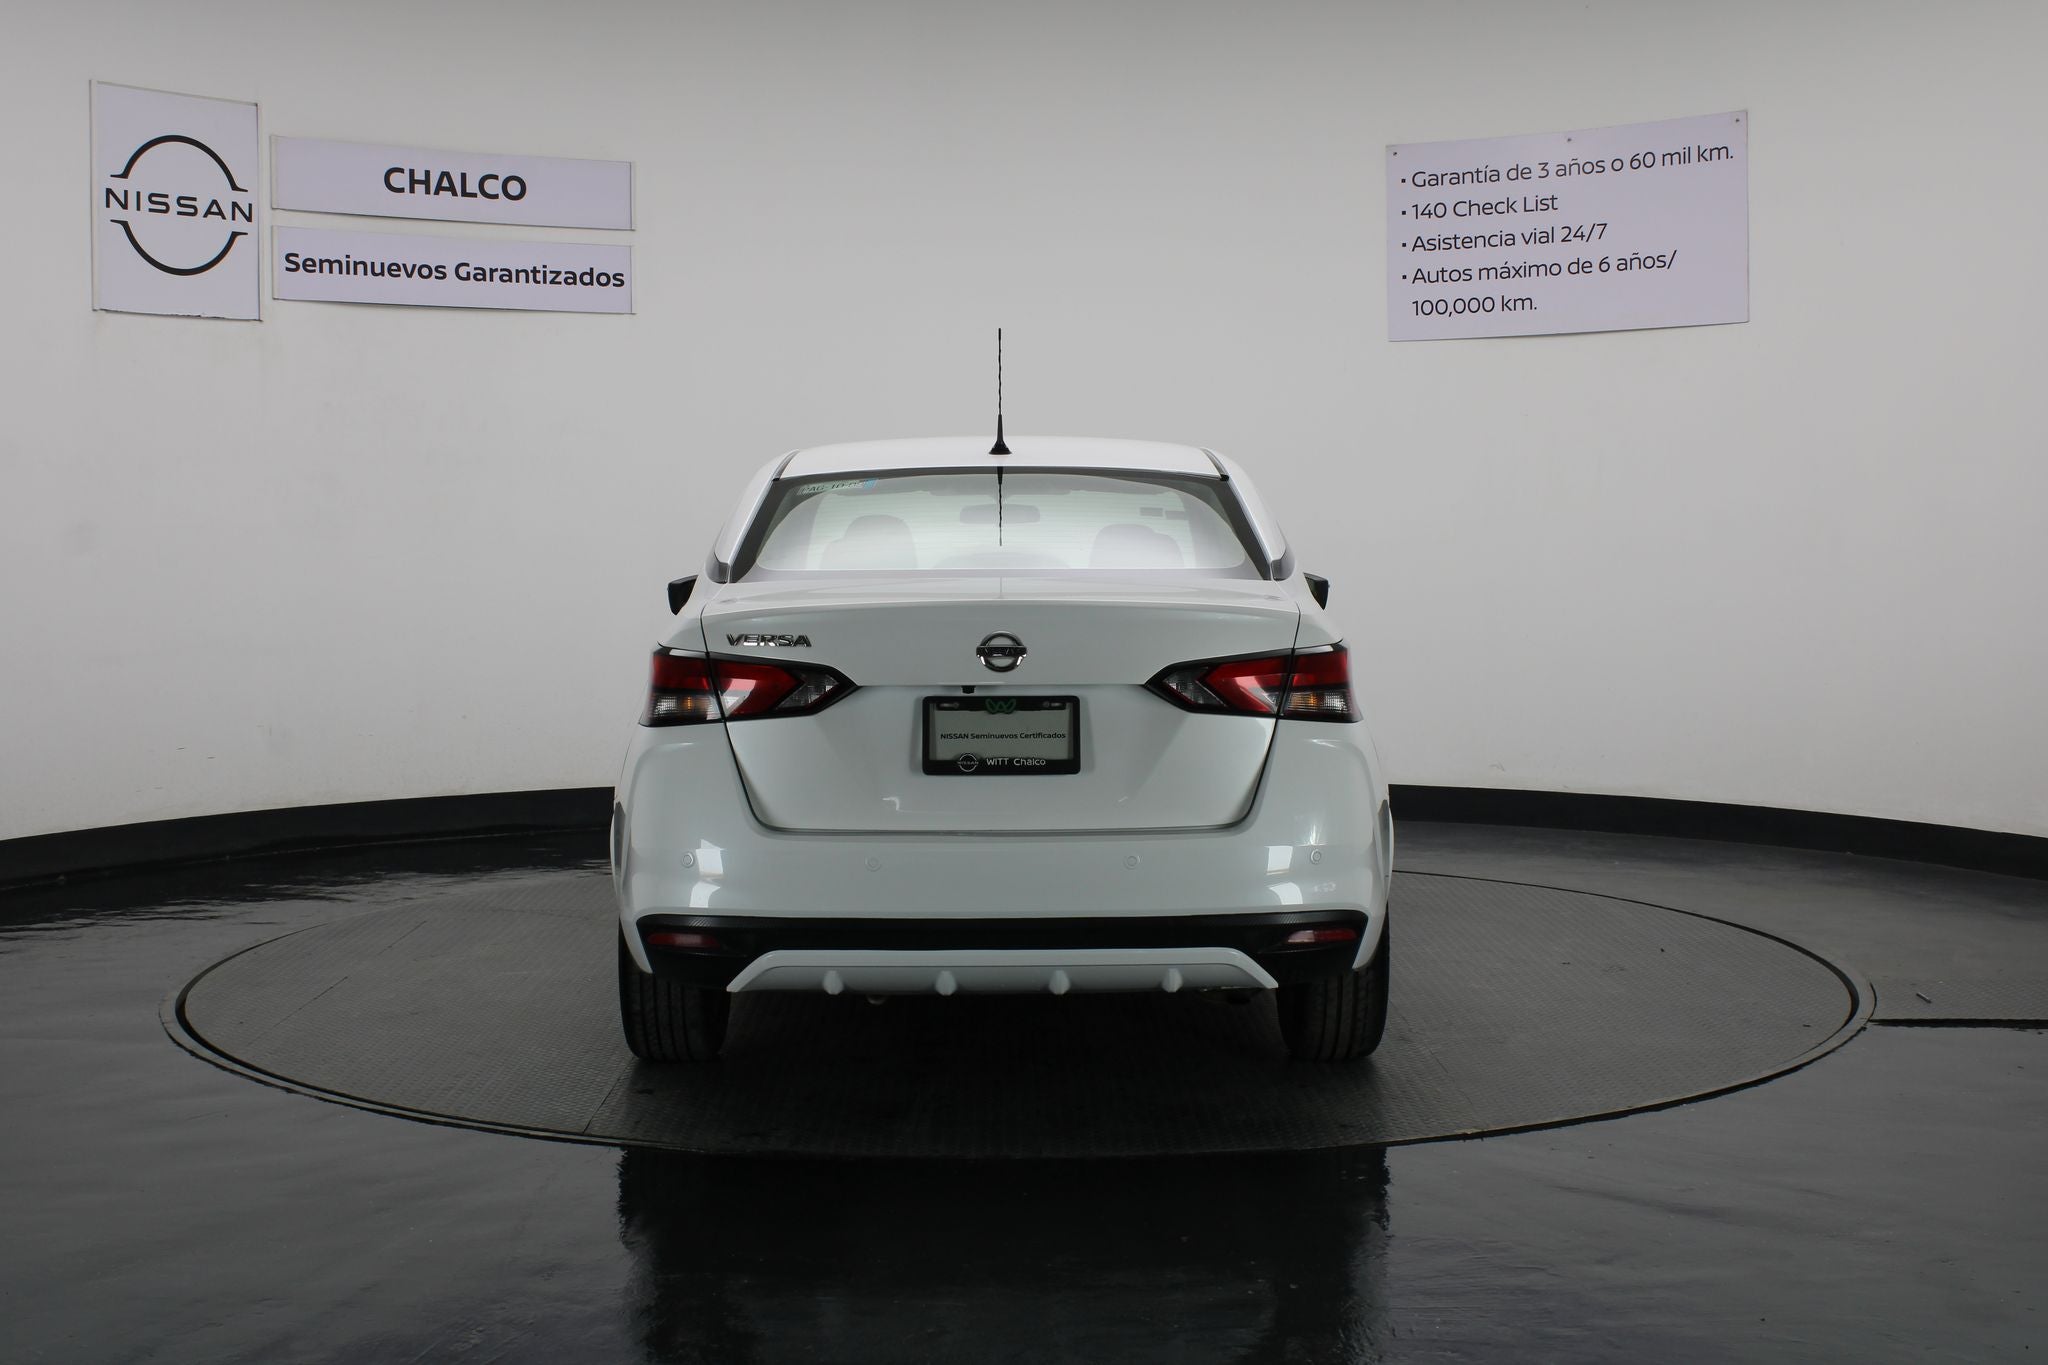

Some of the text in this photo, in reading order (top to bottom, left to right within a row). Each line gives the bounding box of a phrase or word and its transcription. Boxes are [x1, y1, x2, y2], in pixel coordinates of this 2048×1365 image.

[1411, 144, 1735, 188] Garantía de 3 años o 60 mil km.
[383, 166, 528, 202] CHALCO
[105, 187, 254, 223] NISSAN
[1411, 194, 1559, 220] 140 Check List
[1411, 222, 1608, 253] Asistencia vial 24/7
[284, 252, 626, 288] Seminuevos Garantizados
[1411, 249, 1678, 285] Autos máximo de 6 años/
[1411, 294, 1538, 318] 100,000 km.
[726, 633, 812, 648] VERSA
[970, 732, 1018, 740] Seminuevos
[1019, 731, 1066, 739] Certificados
[986, 758, 1009, 766] WITT
[1013, 758, 1046, 766] Chalco
